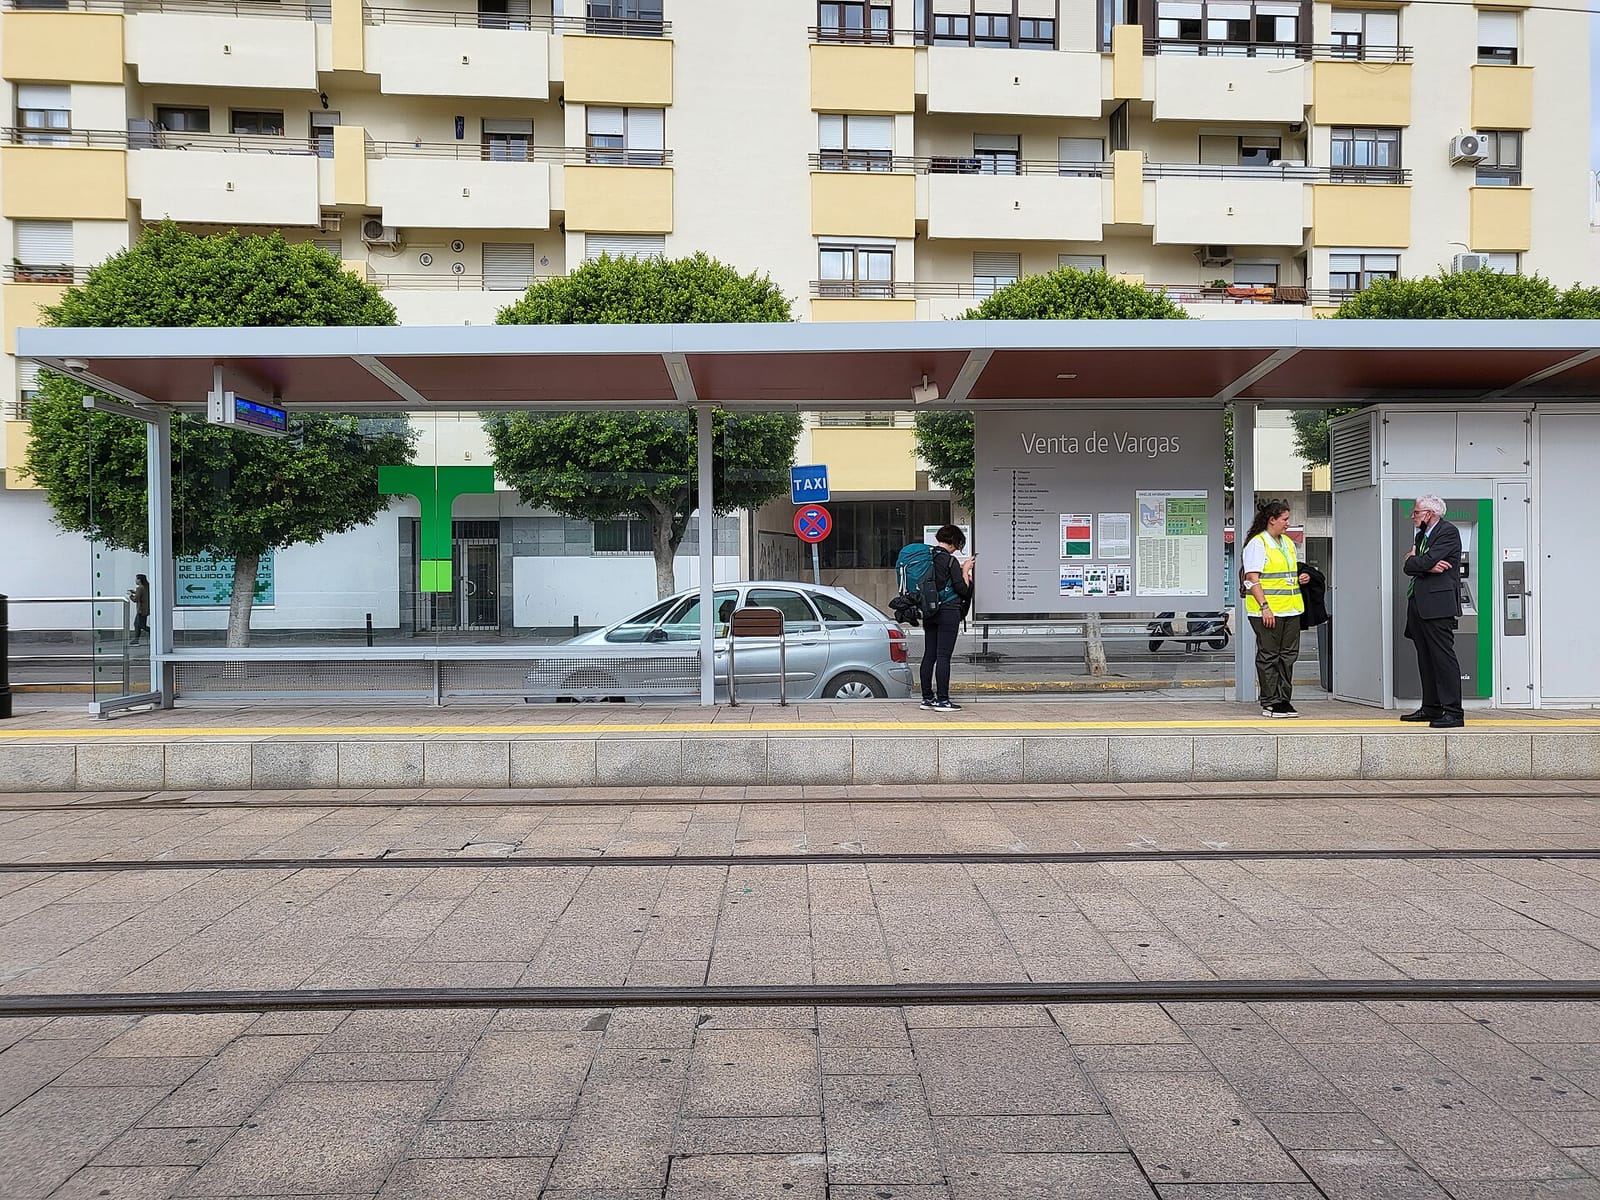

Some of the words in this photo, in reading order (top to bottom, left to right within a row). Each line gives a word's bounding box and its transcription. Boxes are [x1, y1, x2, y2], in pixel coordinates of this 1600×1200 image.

[1021, 432, 1079, 454] Venta
[1085, 431, 1109, 453] de
[1113, 432, 1180, 458] Vargas
[793, 477, 827, 491] TAXI
